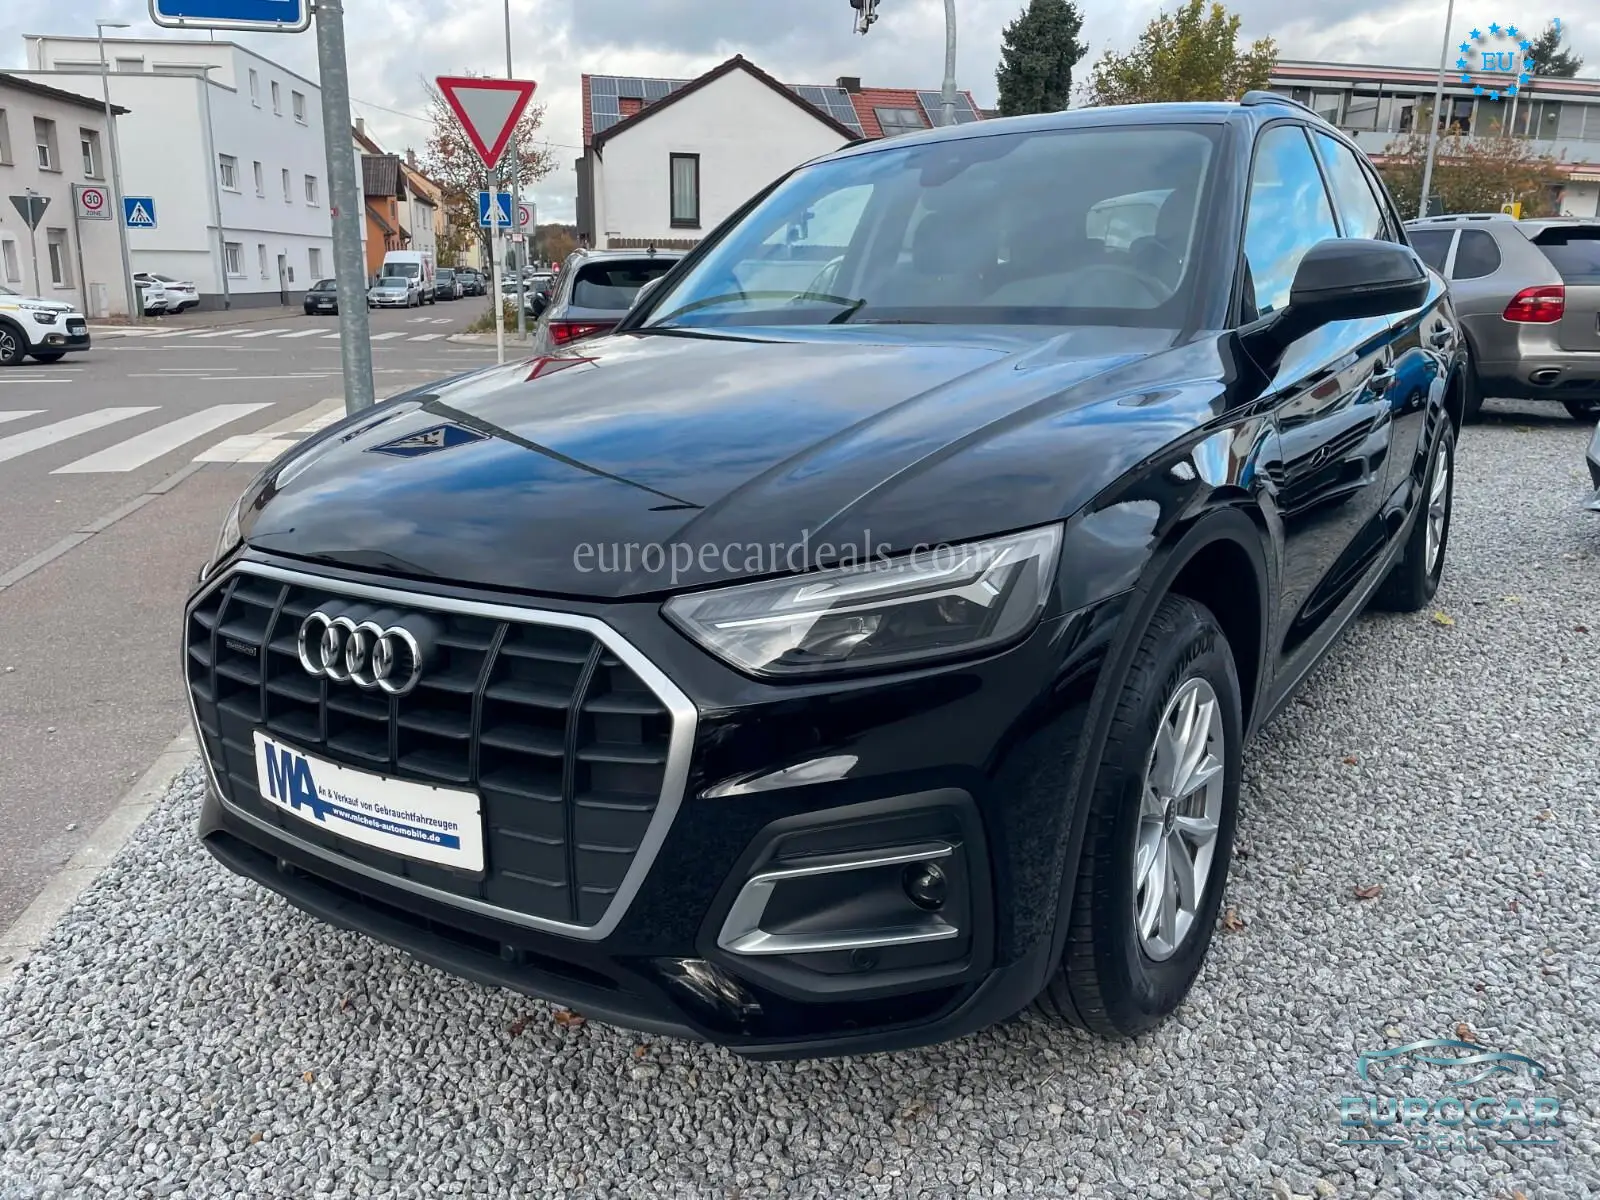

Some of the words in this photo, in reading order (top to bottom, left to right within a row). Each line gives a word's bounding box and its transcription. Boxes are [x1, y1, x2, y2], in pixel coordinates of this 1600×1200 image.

[86, 194, 99, 205] 30
[264, 741, 326, 822] MA
[318, 785, 326, 796] An
[327, 788, 333, 798] &
[334, 790, 359, 808] Verkauf
[360, 801, 373, 812] von
[374, 804, 458, 832] Gebrauchtfahrzeugen
[332, 807, 441, 843] www.michels-automobile.de
